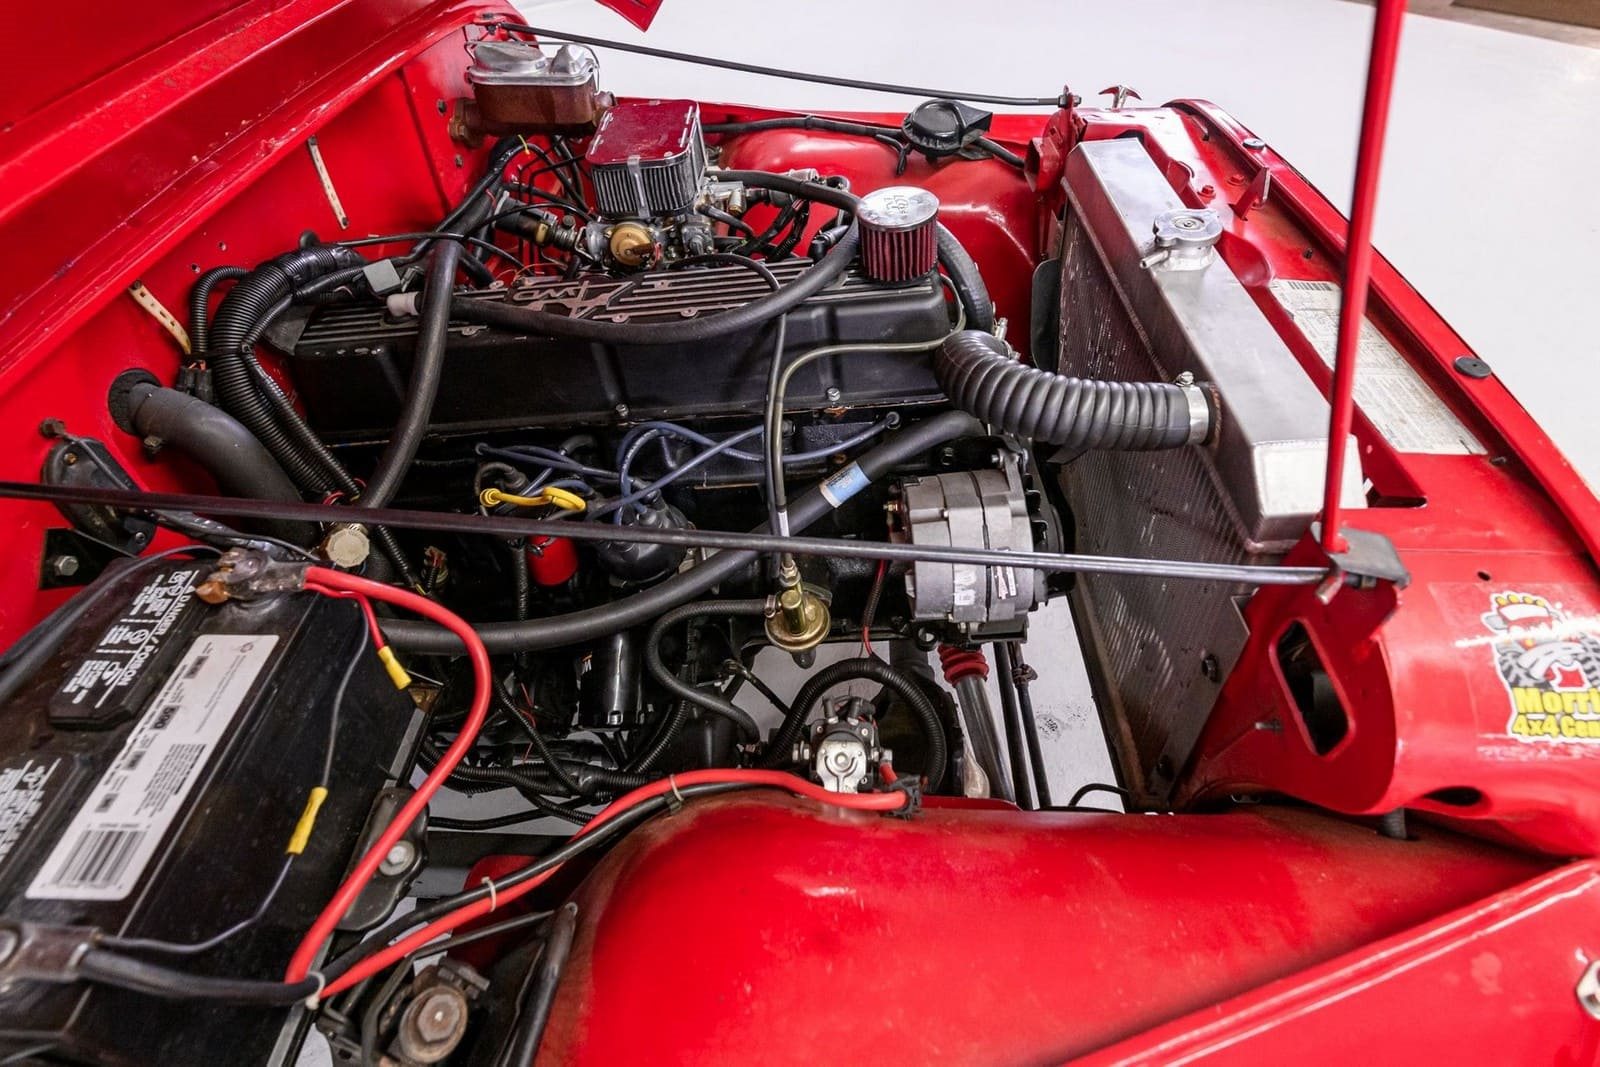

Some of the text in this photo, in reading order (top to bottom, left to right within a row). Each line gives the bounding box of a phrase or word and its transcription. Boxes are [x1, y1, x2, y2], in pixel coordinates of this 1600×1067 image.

[154, 595, 192, 636] DANGER
[117, 645, 157, 686] POISON
[153, 705, 179, 730] 590
[1511, 714, 1560, 738] 4x4
